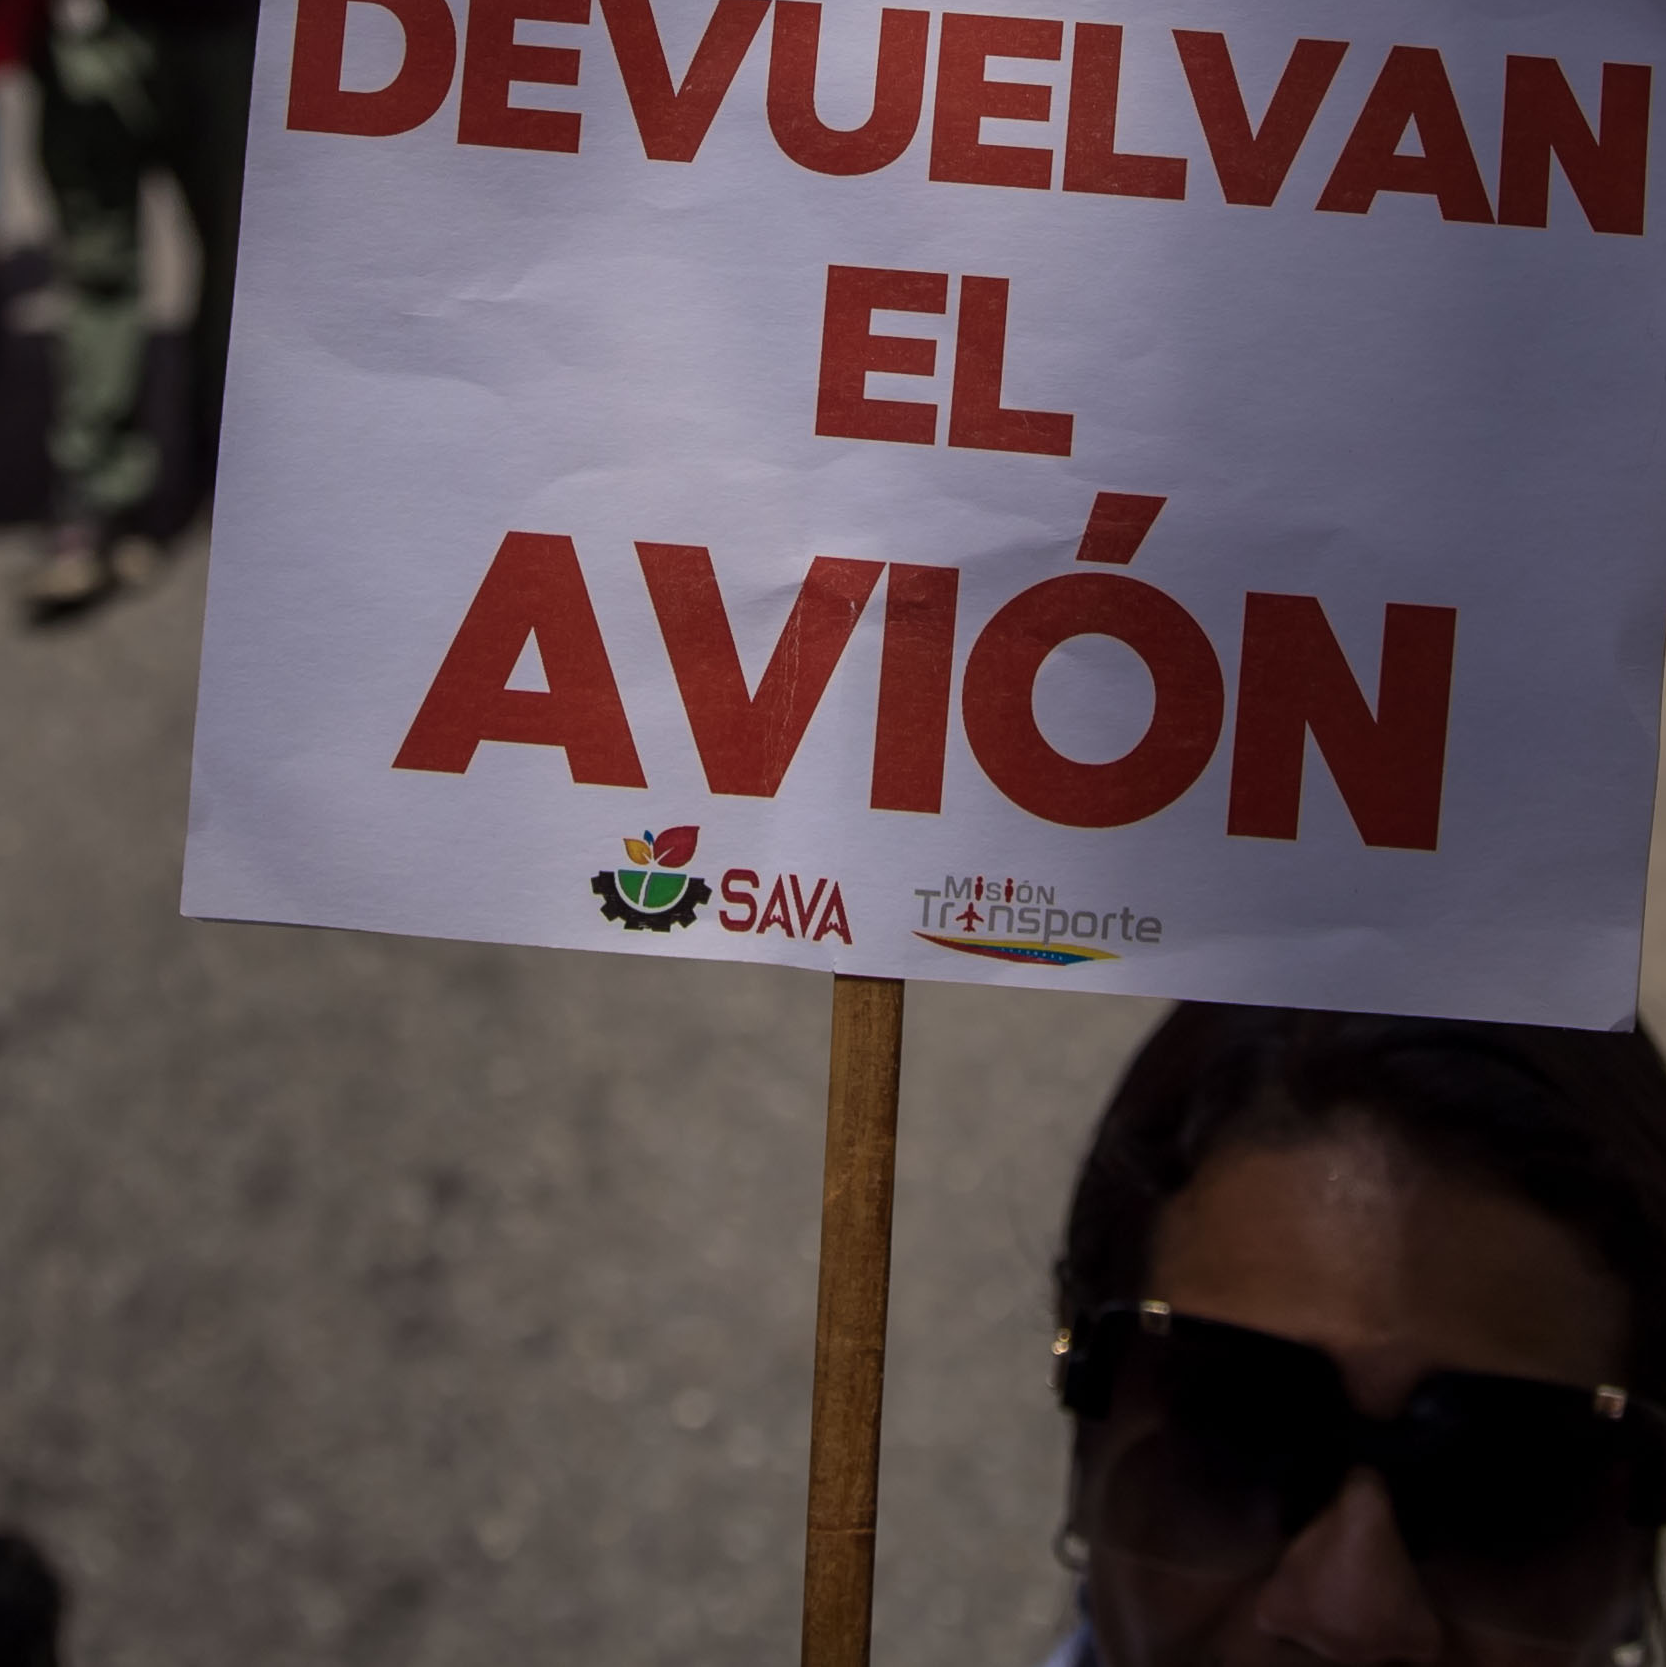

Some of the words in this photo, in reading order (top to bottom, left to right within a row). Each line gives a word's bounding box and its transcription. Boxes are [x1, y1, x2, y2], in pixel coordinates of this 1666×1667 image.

[814, 264, 1075, 457] EL
[391, 491, 1458, 852] AVIÓN
[718, 868, 853, 946] SAVA
